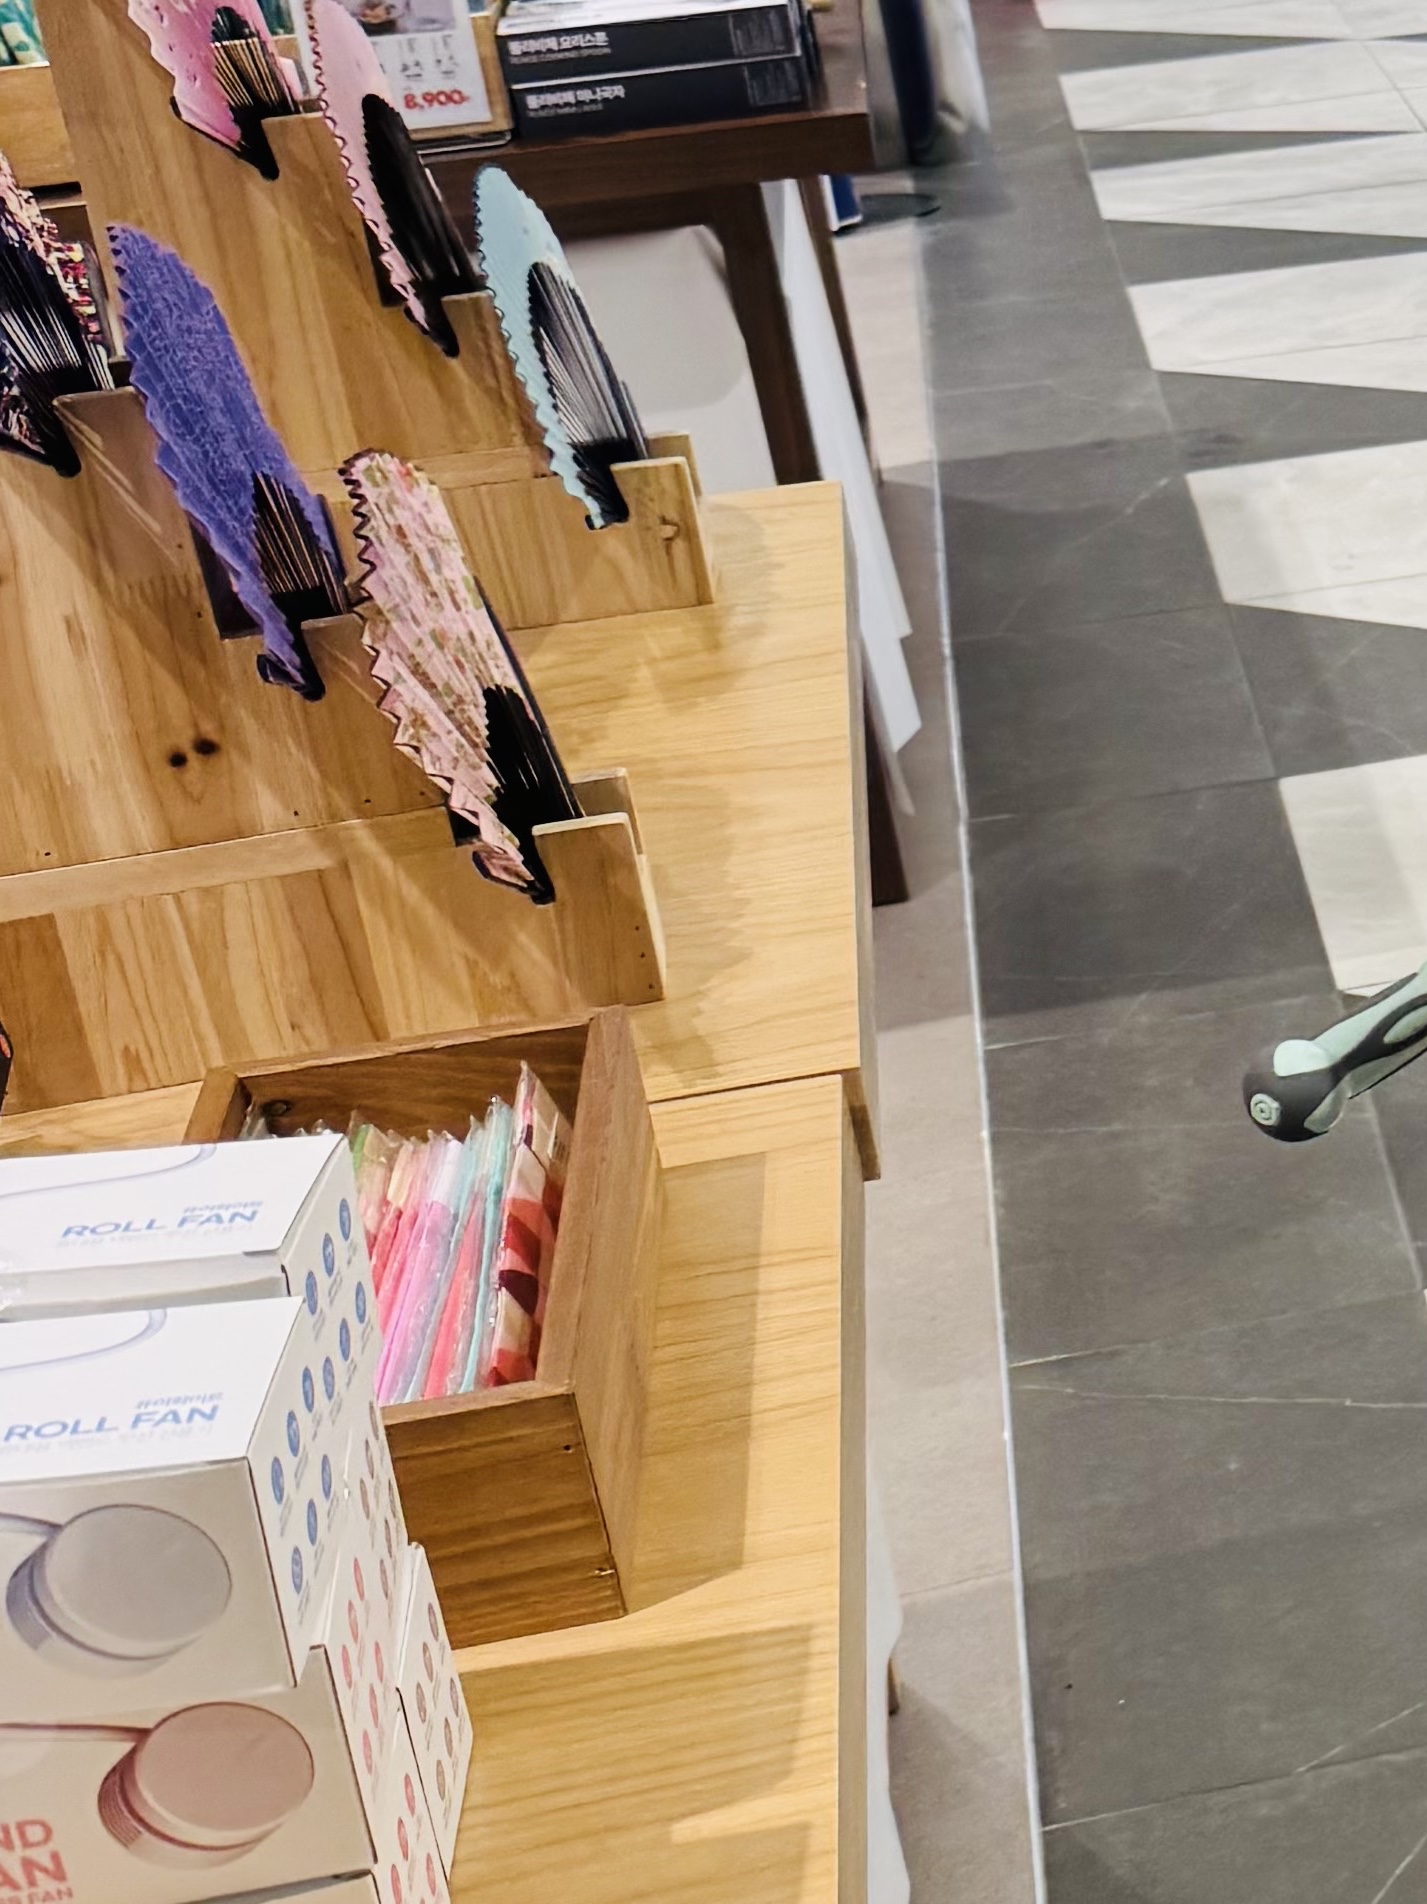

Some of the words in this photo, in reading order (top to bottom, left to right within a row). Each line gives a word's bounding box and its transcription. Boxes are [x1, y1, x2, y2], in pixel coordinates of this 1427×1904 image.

[61, 1218, 168, 1239] ROLL
[176, 1209, 260, 1229] FAN
[3, 1416, 119, 1443] ROLL
[130, 1404, 220, 1430] FAN
